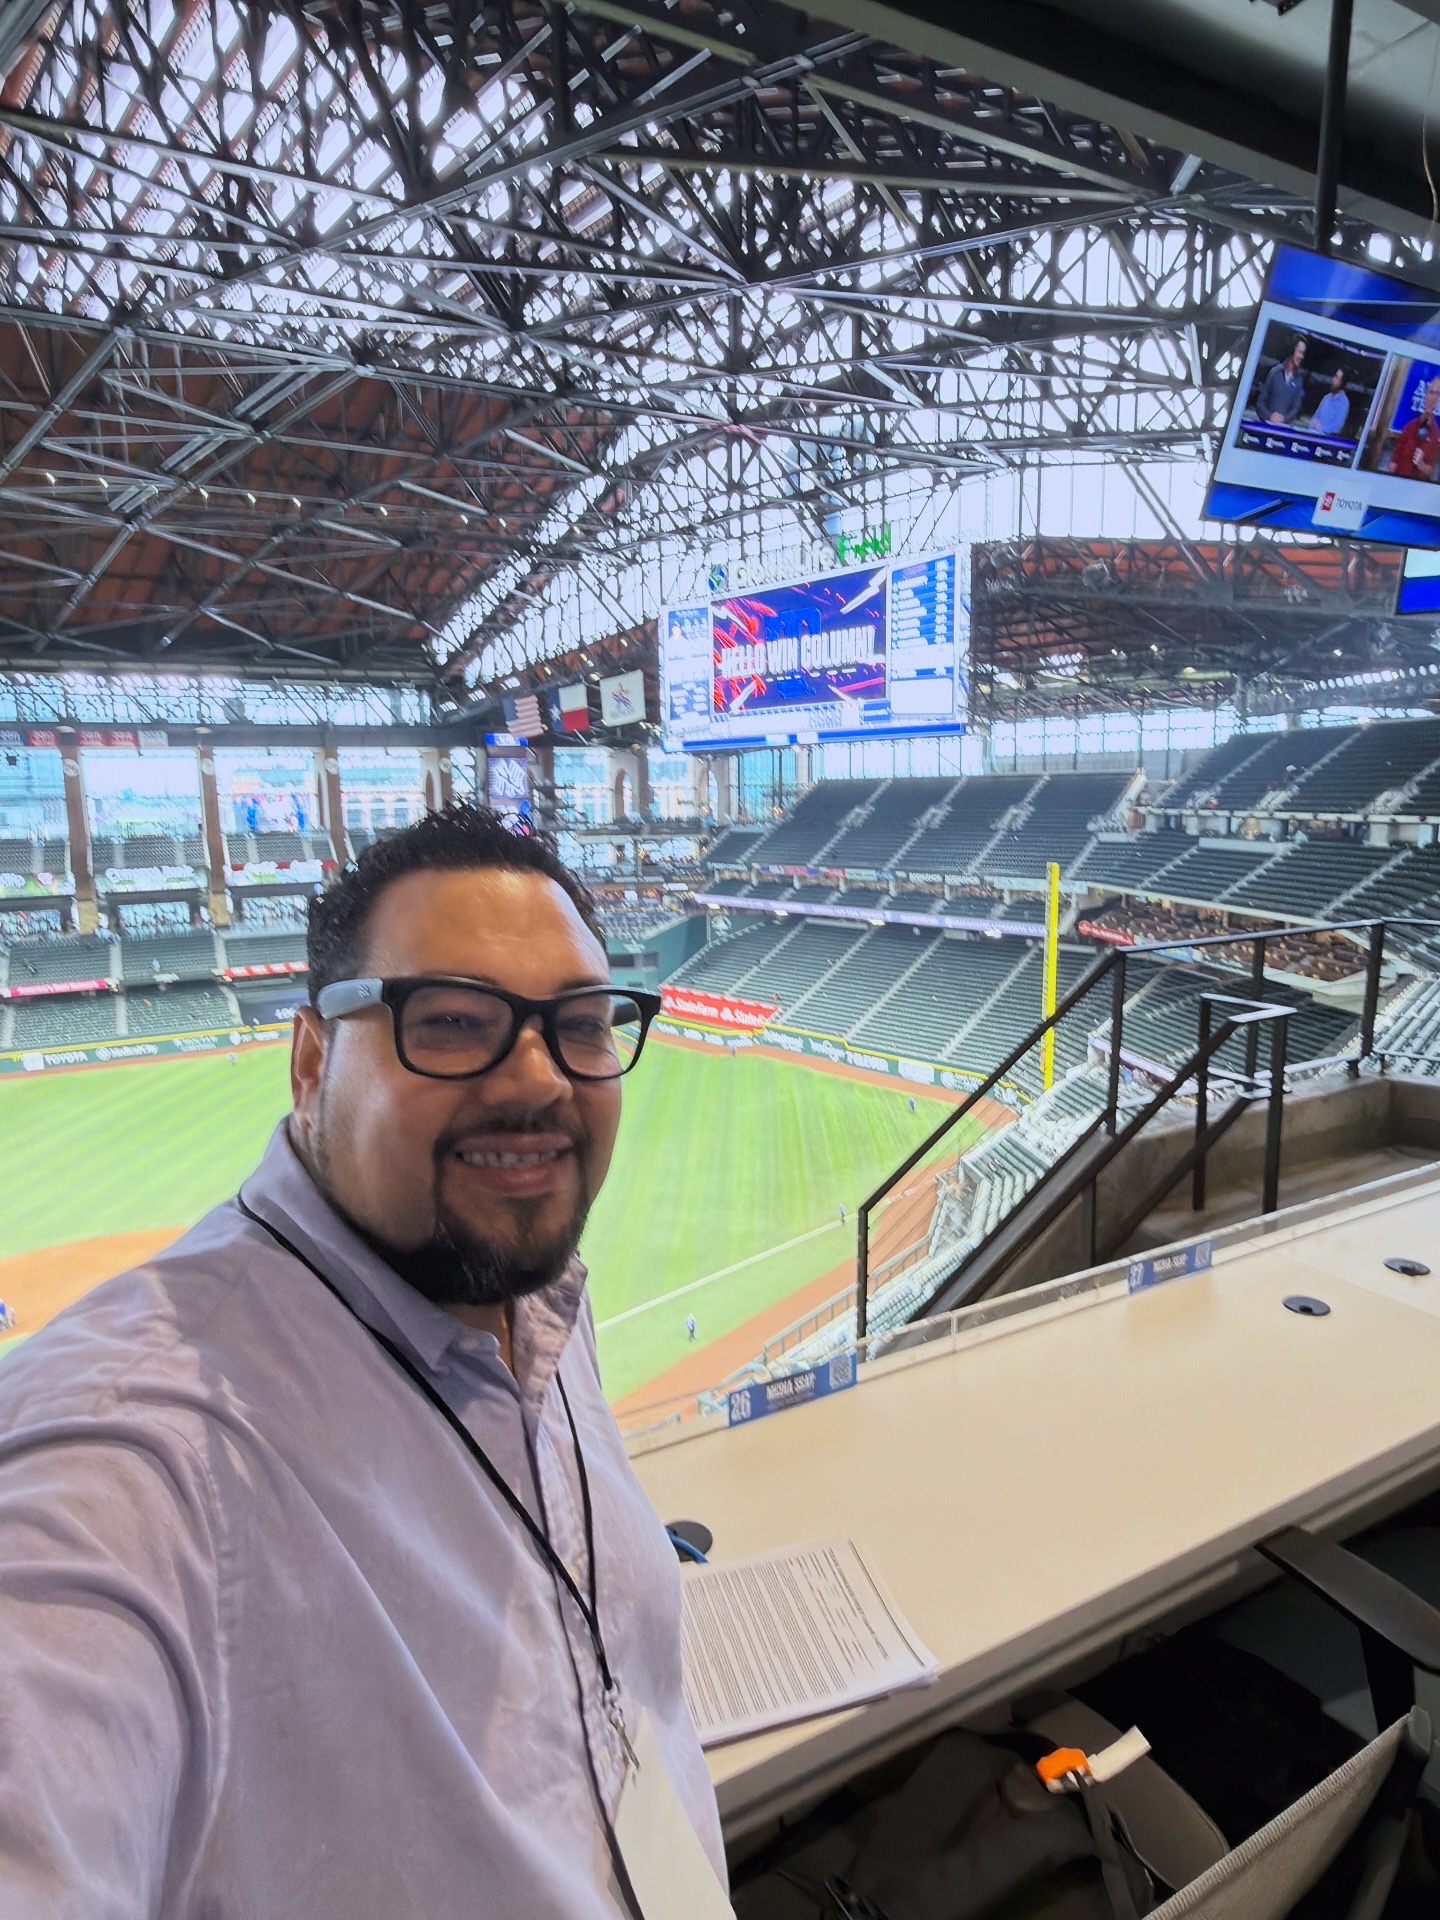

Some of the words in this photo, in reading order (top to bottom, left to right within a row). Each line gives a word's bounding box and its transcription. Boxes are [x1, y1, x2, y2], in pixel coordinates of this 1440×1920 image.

[1336, 499, 1362, 510] TOYOTA
[766, 637, 799, 675] WIN
[44, 1051, 88, 1066] TOYOTA
[730, 1389, 752, 1422] 26
